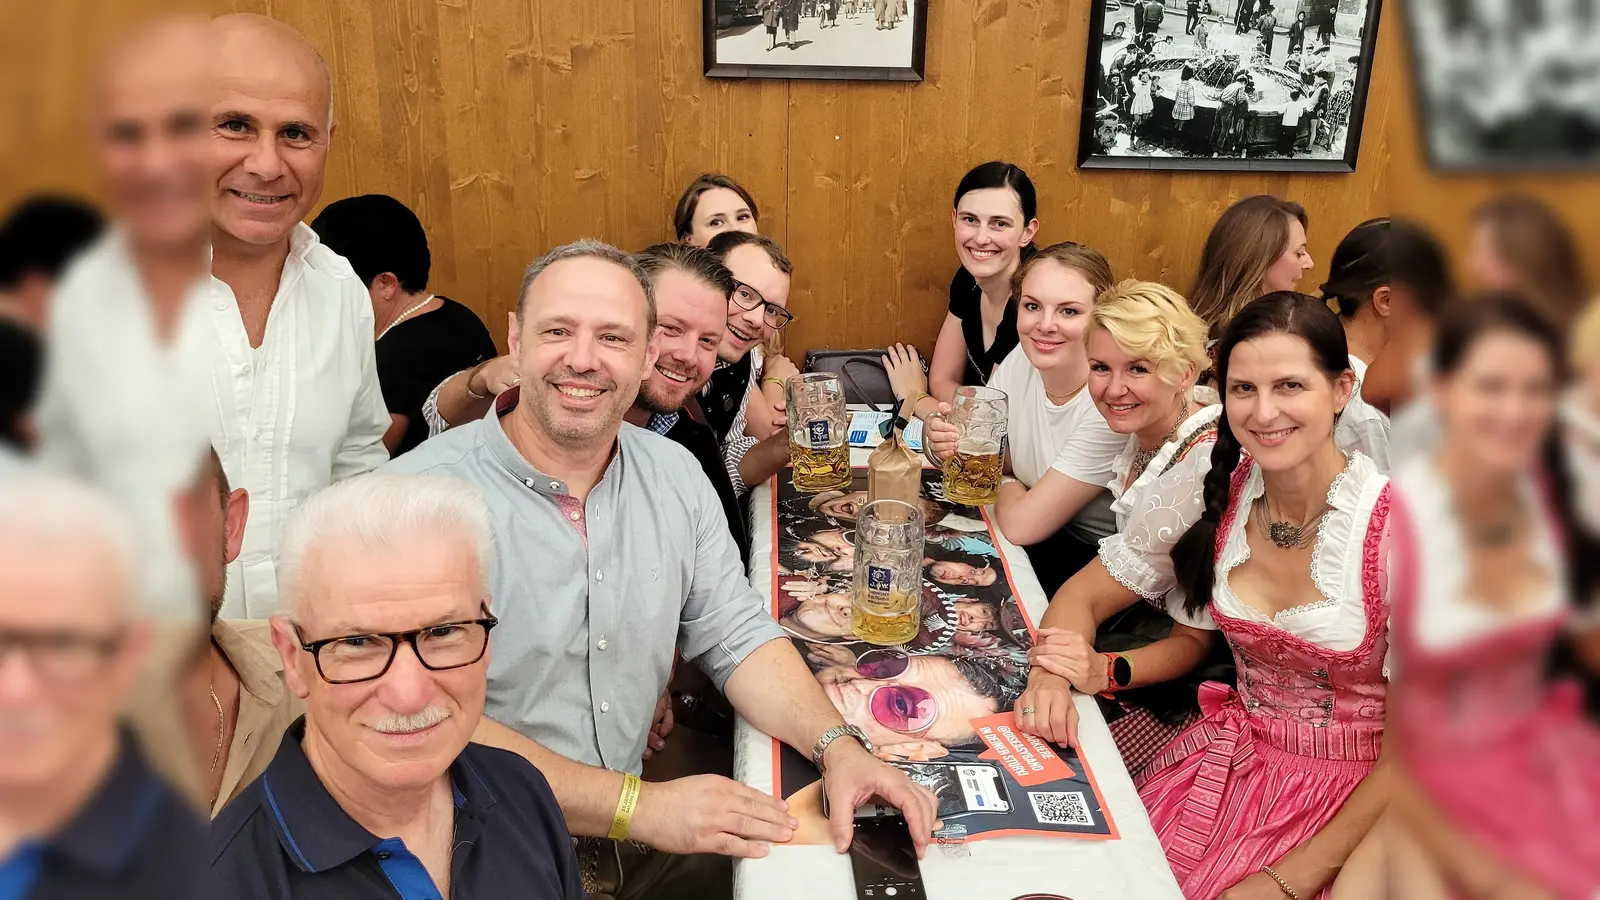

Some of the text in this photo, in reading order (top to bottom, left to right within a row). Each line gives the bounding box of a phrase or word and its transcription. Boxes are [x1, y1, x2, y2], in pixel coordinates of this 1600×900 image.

[979, 726, 1029, 777] IN DEINER STORY!
